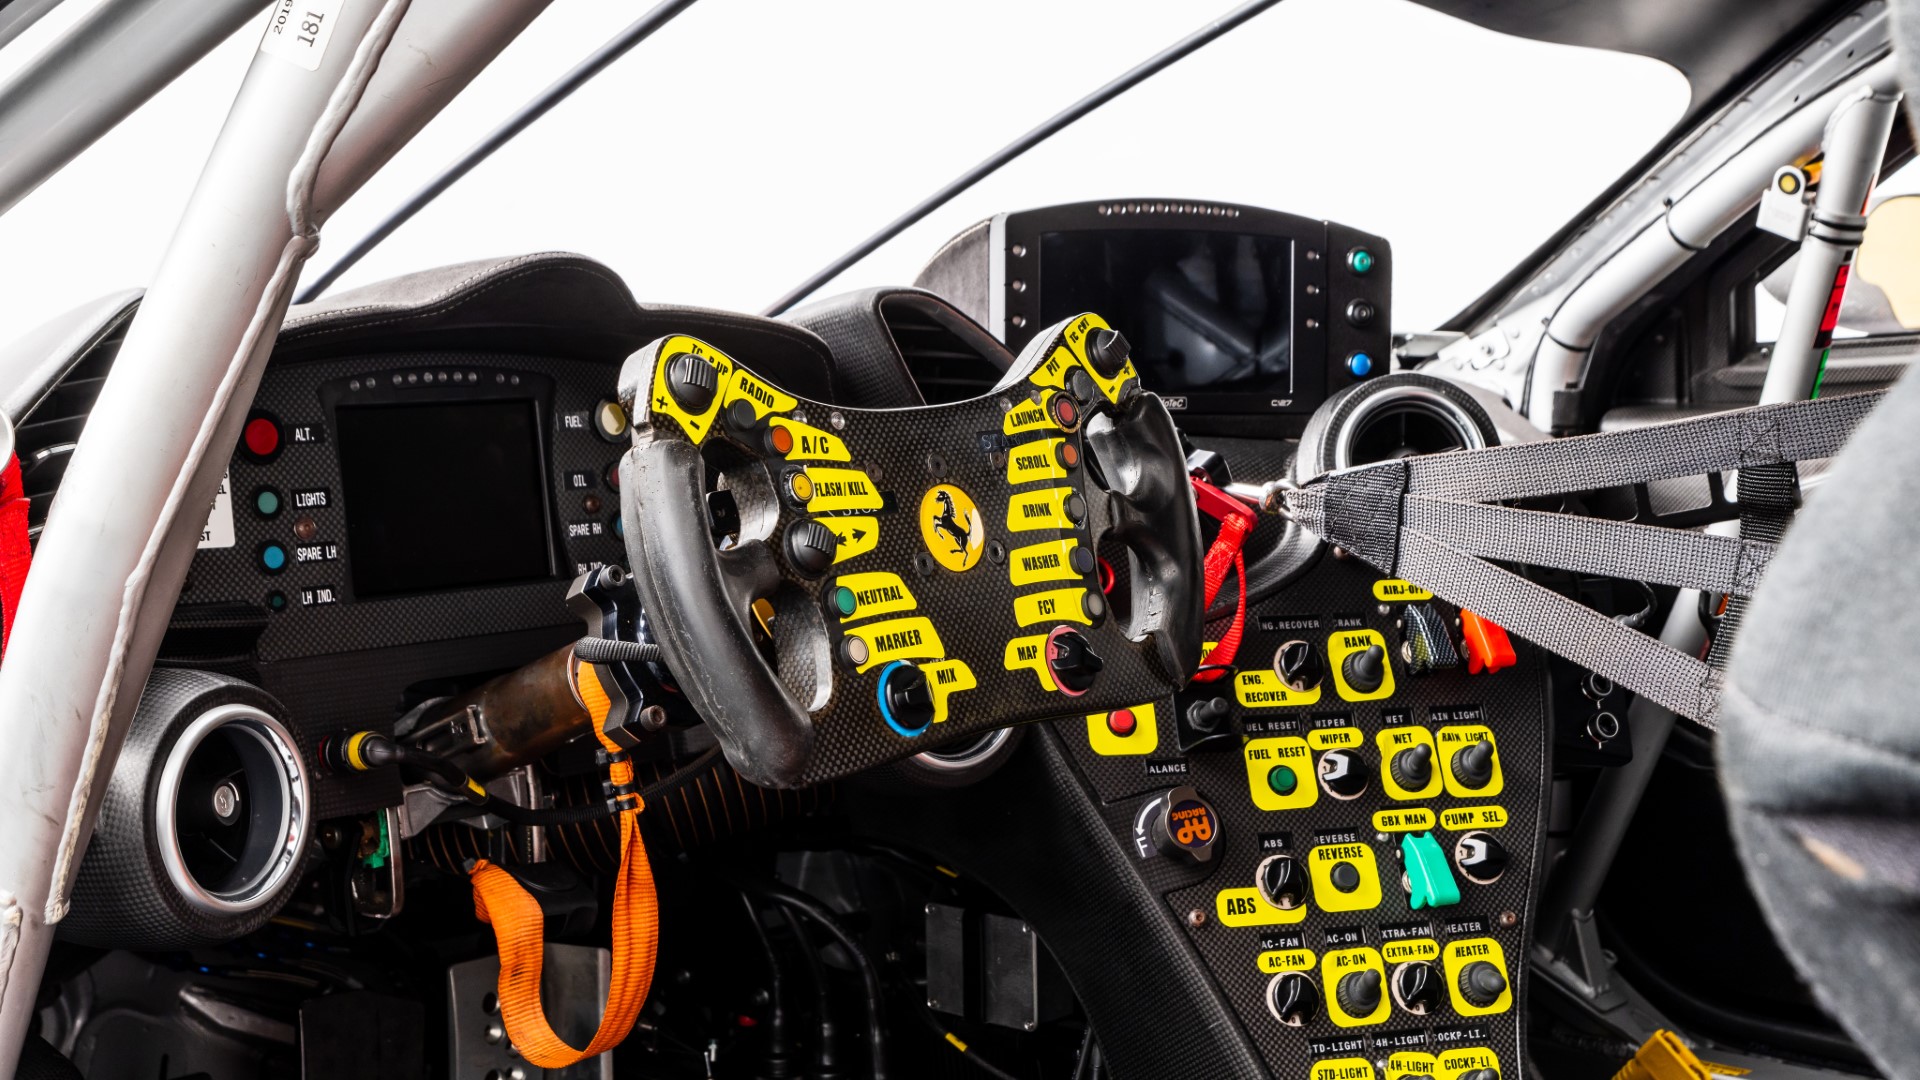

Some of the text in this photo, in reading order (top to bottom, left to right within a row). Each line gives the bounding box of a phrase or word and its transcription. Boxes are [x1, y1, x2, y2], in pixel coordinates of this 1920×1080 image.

[297, 11, 325, 47] 181
[1046, 358, 1060, 377] PIT
[739, 377, 775, 408] RADIO
[1161, 398, 1184, 408] oTeC
[565, 415, 583, 428] FUEL
[1009, 408, 1046, 428] LAUNCH
[295, 427, 315, 441] ALT.
[801, 435, 830, 455] A/C
[1015, 454, 1051, 471] SCROLL
[573, 474, 587, 487] OIL
[296, 492, 326, 507] LIGHTS
[1022, 503, 1052, 518] DRINK
[569, 522, 602, 537] SPARE RH
[297, 545, 337, 562] SPARE LH
[1022, 553, 1060, 572] WASHER
[301, 589, 336, 605] LH IND.
[857, 585, 904, 607] NEUTRAL
[1037, 599, 1056, 615] FCY
[874, 629, 923, 653] MARKER
[1344, 635, 1373, 648] RANK
[1017, 645, 1038, 661] MAP
[936, 667, 957, 685] MIX
[1242, 674, 1264, 686] ENG.
[1245, 691, 1288, 703] RECOVER
[1385, 715, 1403, 724] WET
[1432, 710, 1480, 721] AIN LIGHT
[1268, 721, 1297, 730] RESET
[1315, 719, 1346, 728] WIPER
[1320, 733, 1351, 744] WIPER
[1393, 733, 1413, 745] WET
[1442, 731, 1489, 742] RAIN LIGHT
[1248, 746, 1306, 760] FUEL RESET
[1149, 763, 1187, 774] ALANCE
[1171, 806, 1207, 821] RACING
[1381, 813, 1427, 827] GBX MAN
[1444, 811, 1503, 826] PUMP SEL.
[1264, 839, 1283, 848] ABS
[1313, 832, 1356, 844] REVERSE
[1136, 837, 1148, 858] F
[1318, 846, 1363, 861] REVERSE
[1227, 897, 1257, 915] ABS
[1326, 932, 1358, 944] AC-ON
[1381, 926, 1430, 939] XTRA-FAN
[1261, 938, 1299, 949] AC-FAN
[1386, 944, 1435, 958] EXTRA-FAN
[1455, 944, 1490, 958] HEATER
[1268, 954, 1306, 968] AC-FAN
[1336, 954, 1367, 967] AC-ON
[1318, 1066, 1368, 1080] STD-LIGHT
